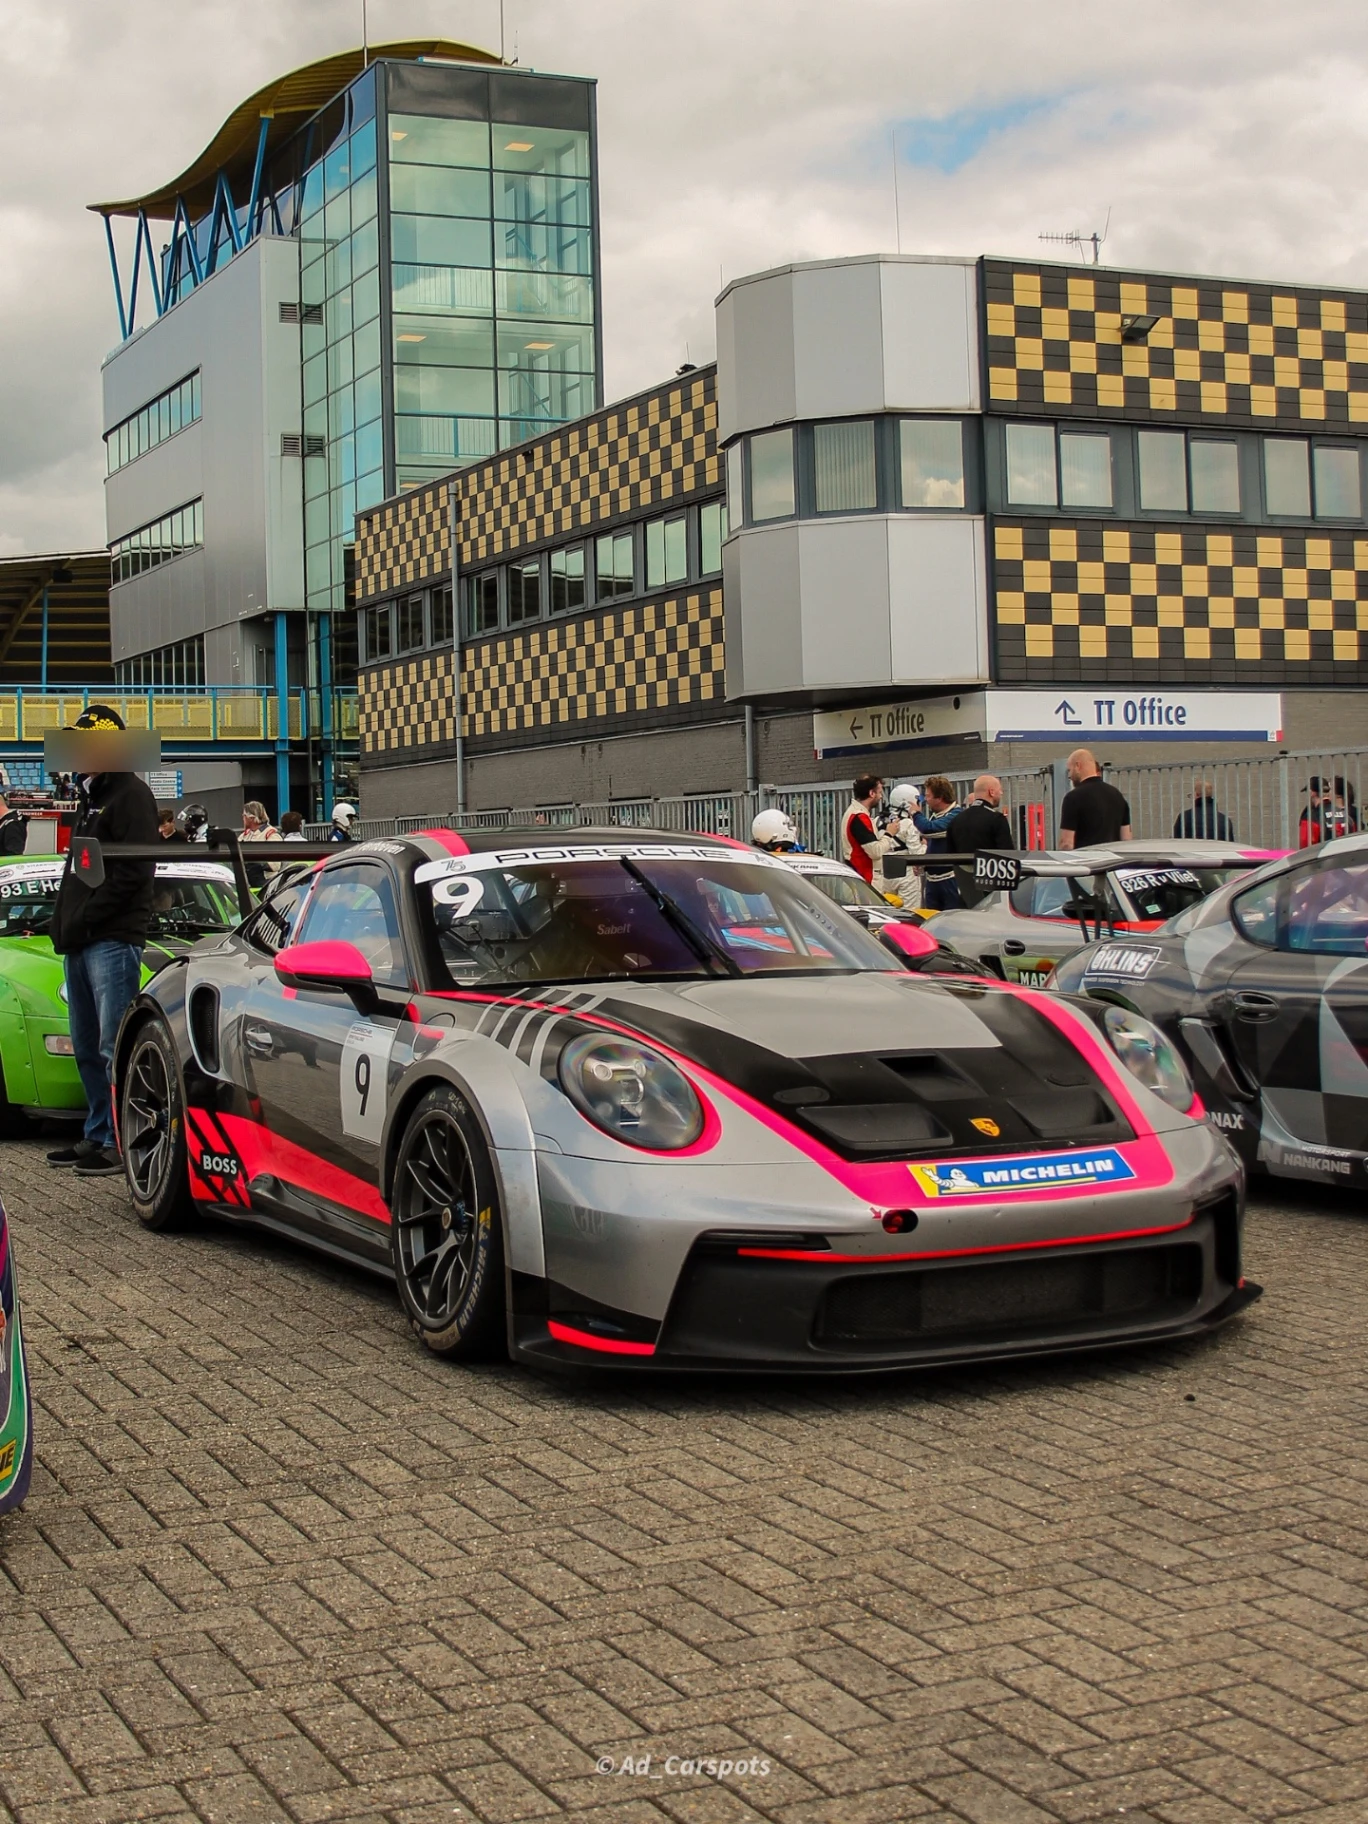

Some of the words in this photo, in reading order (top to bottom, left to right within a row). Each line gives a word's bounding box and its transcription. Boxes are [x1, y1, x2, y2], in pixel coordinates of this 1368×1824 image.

[869, 713, 883, 738] TT
[886, 707, 925, 737] Office
[1093, 700, 1116, 726] TT
[1123, 697, 1187, 726] Office
[494, 847, 733, 864] PORSCHE
[975, 857, 1017, 880] BOSS
[0, 884, 23, 899] 93
[26, 880, 39, 894] E
[41, 879, 61, 892] He
[1120, 876, 1149, 893] 926
[1145, 874, 1162, 887] R
[1158, 875, 1168, 884] v
[1165, 870, 1200, 884] Vliet
[432, 875, 485, 920] 9
[596, 922, 632, 936] Sabelt
[1090, 945, 1154, 974] ÖHLINS
[354, 1053, 371, 1117] 9
[1205, 1110, 1244, 1130] NAX
[202, 1154, 238, 1175] BOSS
[982, 1159, 1115, 1184] MICHELIN
[1283, 1152, 1351, 1175] NANKANG
[459, 1244, 487, 1329] MICHELIN
